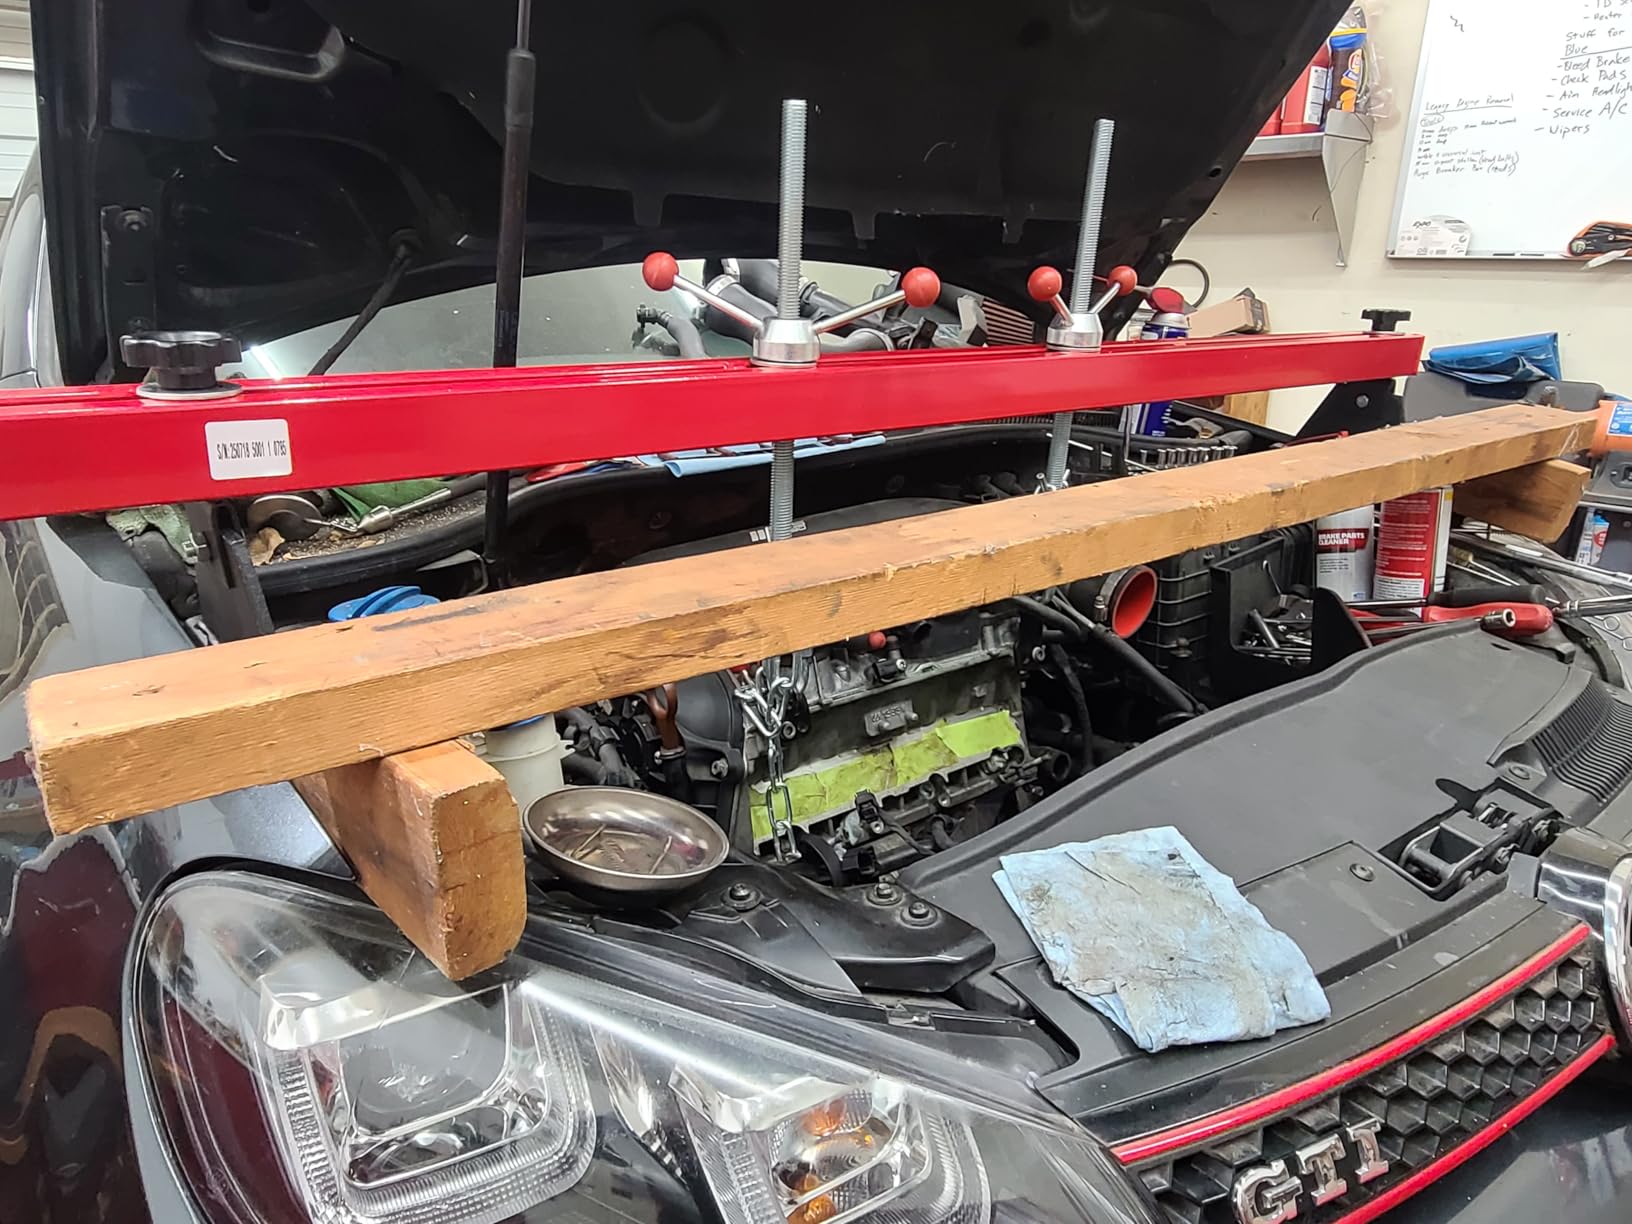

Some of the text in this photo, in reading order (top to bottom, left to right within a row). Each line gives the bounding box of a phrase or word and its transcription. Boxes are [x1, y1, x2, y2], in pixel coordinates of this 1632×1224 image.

[1565, 28, 1625, 42] Stuff for
[1564, 43, 1588, 57] Blue
[1560, 72, 1590, 86] Check
[1552, 97, 1628, 120] Service A/C
[1232, 1118, 1389, 1224] GTI
